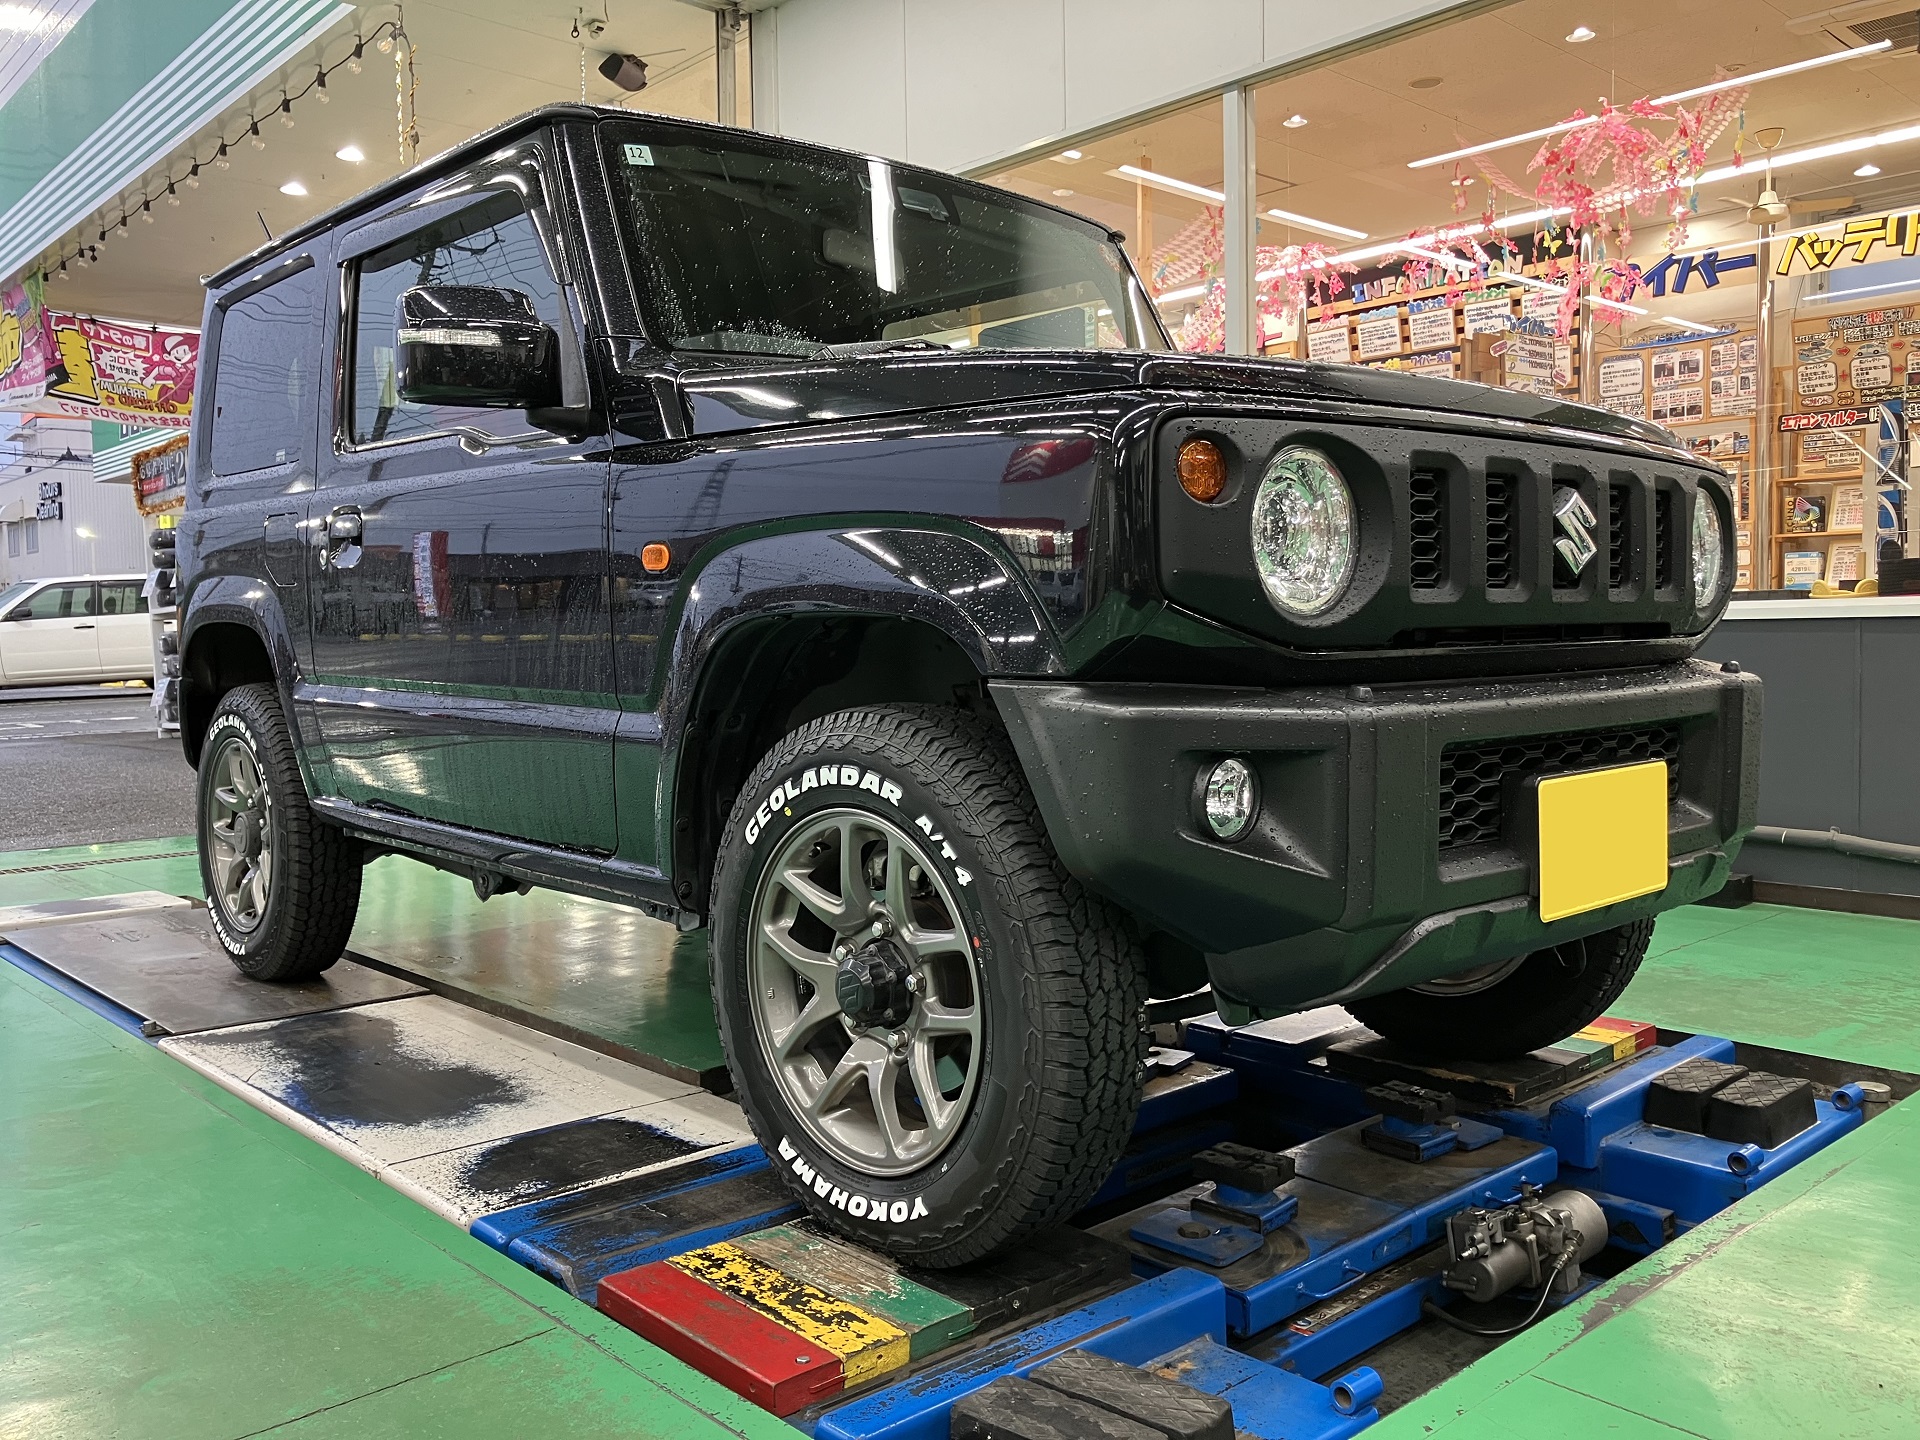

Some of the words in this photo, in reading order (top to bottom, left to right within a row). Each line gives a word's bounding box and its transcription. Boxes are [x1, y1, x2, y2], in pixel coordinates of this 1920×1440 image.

[629, 147, 644, 159] 12
[1781, 410, 1867, 430] エアコンフィルター
[209, 714, 257, 753] GEOLANDAR
[745, 765, 903, 845] GEOLANDAR
[207, 895, 246, 956] YOKOHAMA
[777, 1135, 929, 1223] YOKOHAMA
